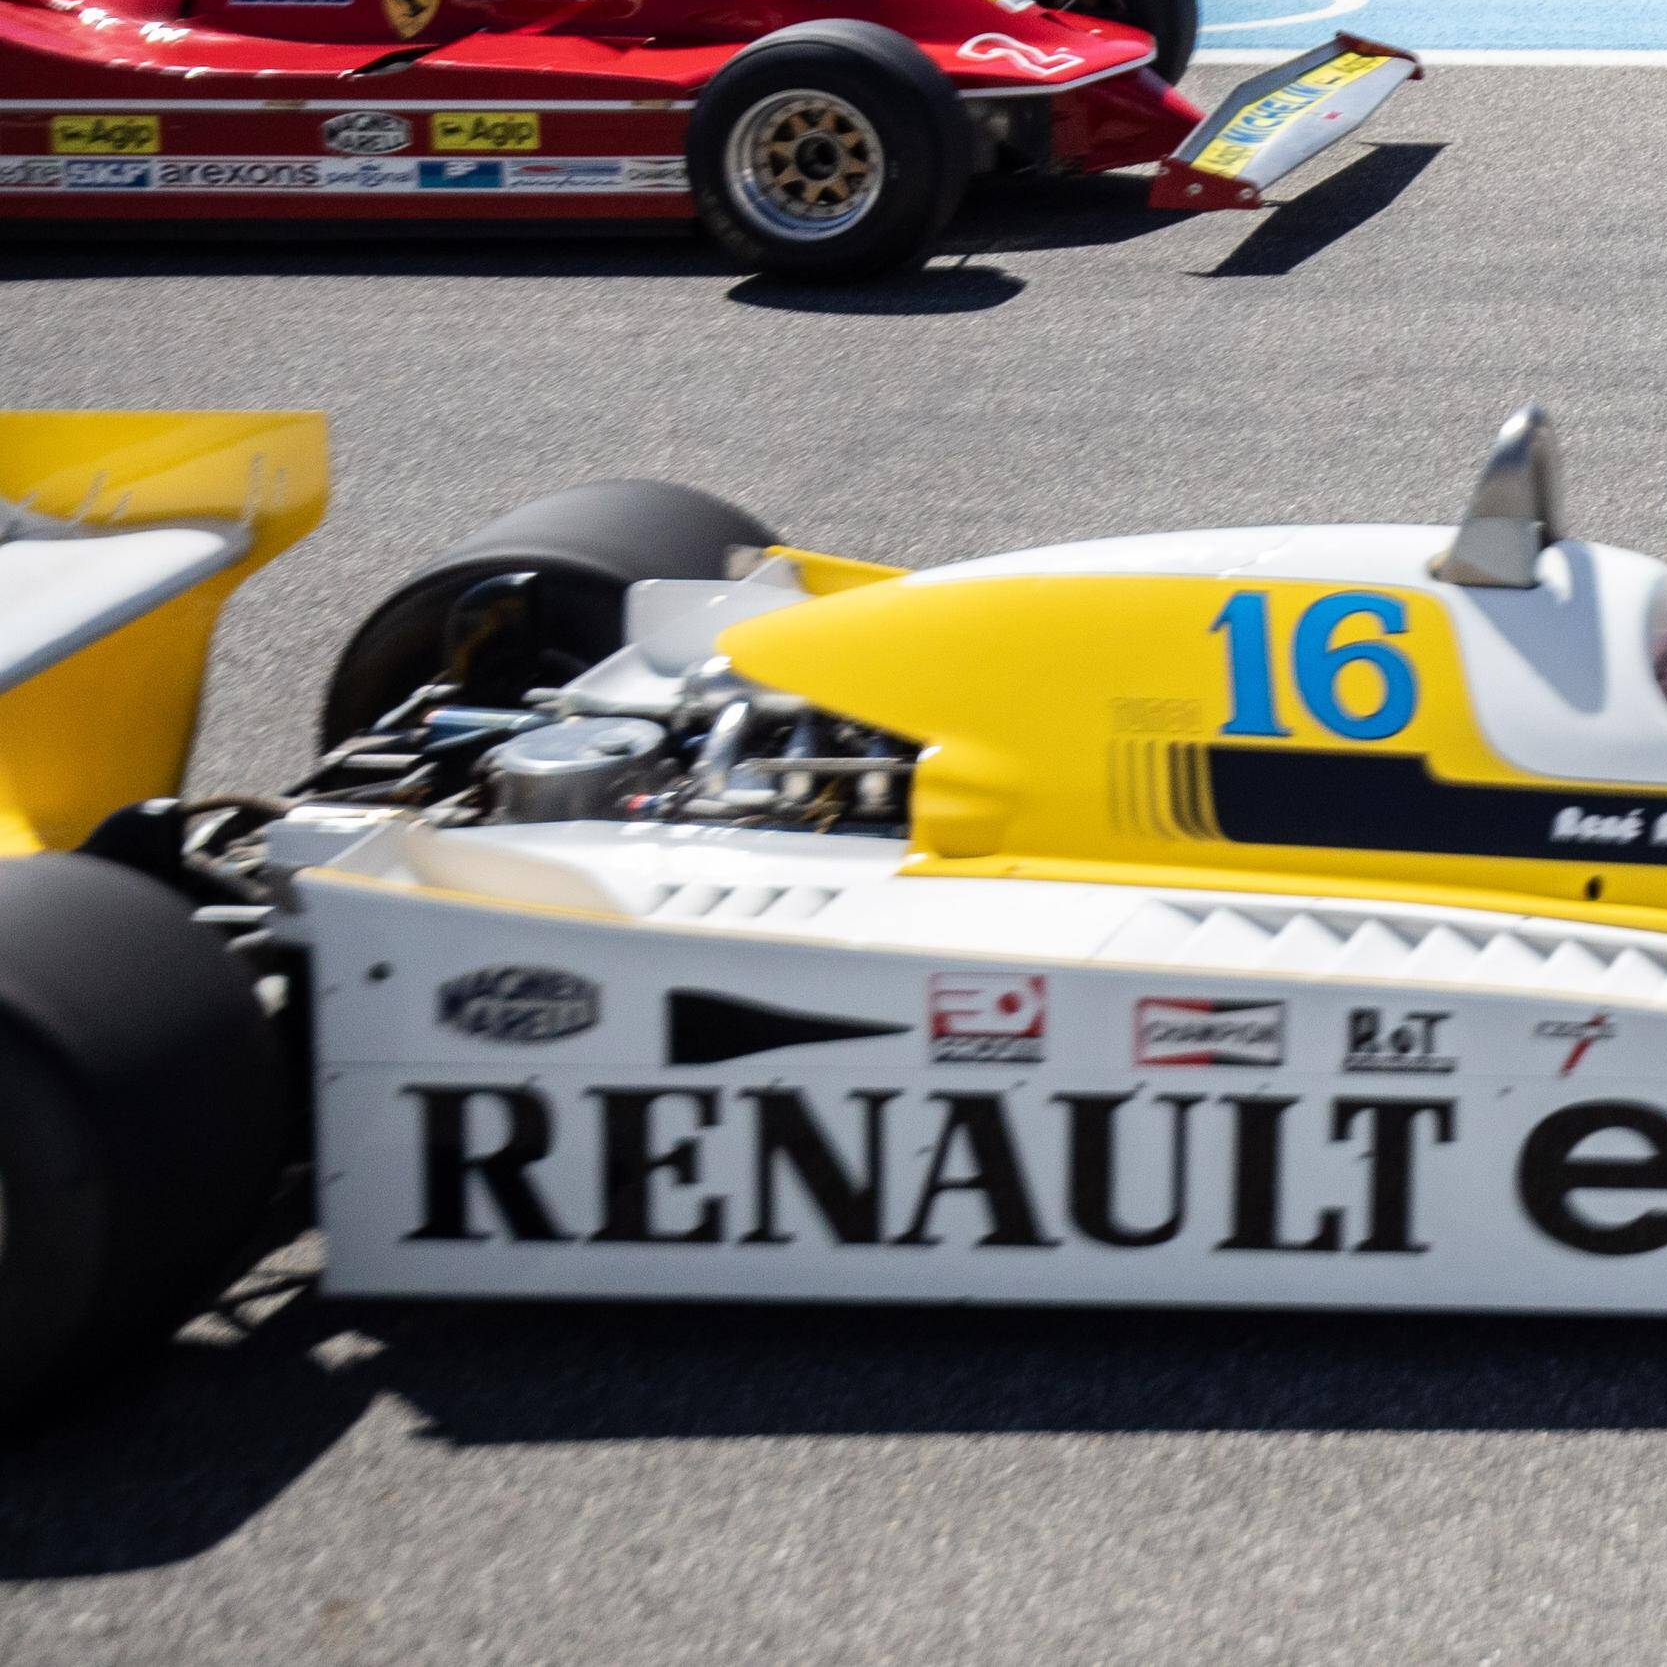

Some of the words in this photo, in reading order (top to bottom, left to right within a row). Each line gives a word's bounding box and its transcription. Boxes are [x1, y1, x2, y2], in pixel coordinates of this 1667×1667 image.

[160, 161, 322, 185] arexons
[468, 116, 535, 147] Agip
[1208, 589, 1419, 741] 16
[400, 1083, 1457, 1256] RENAULT
